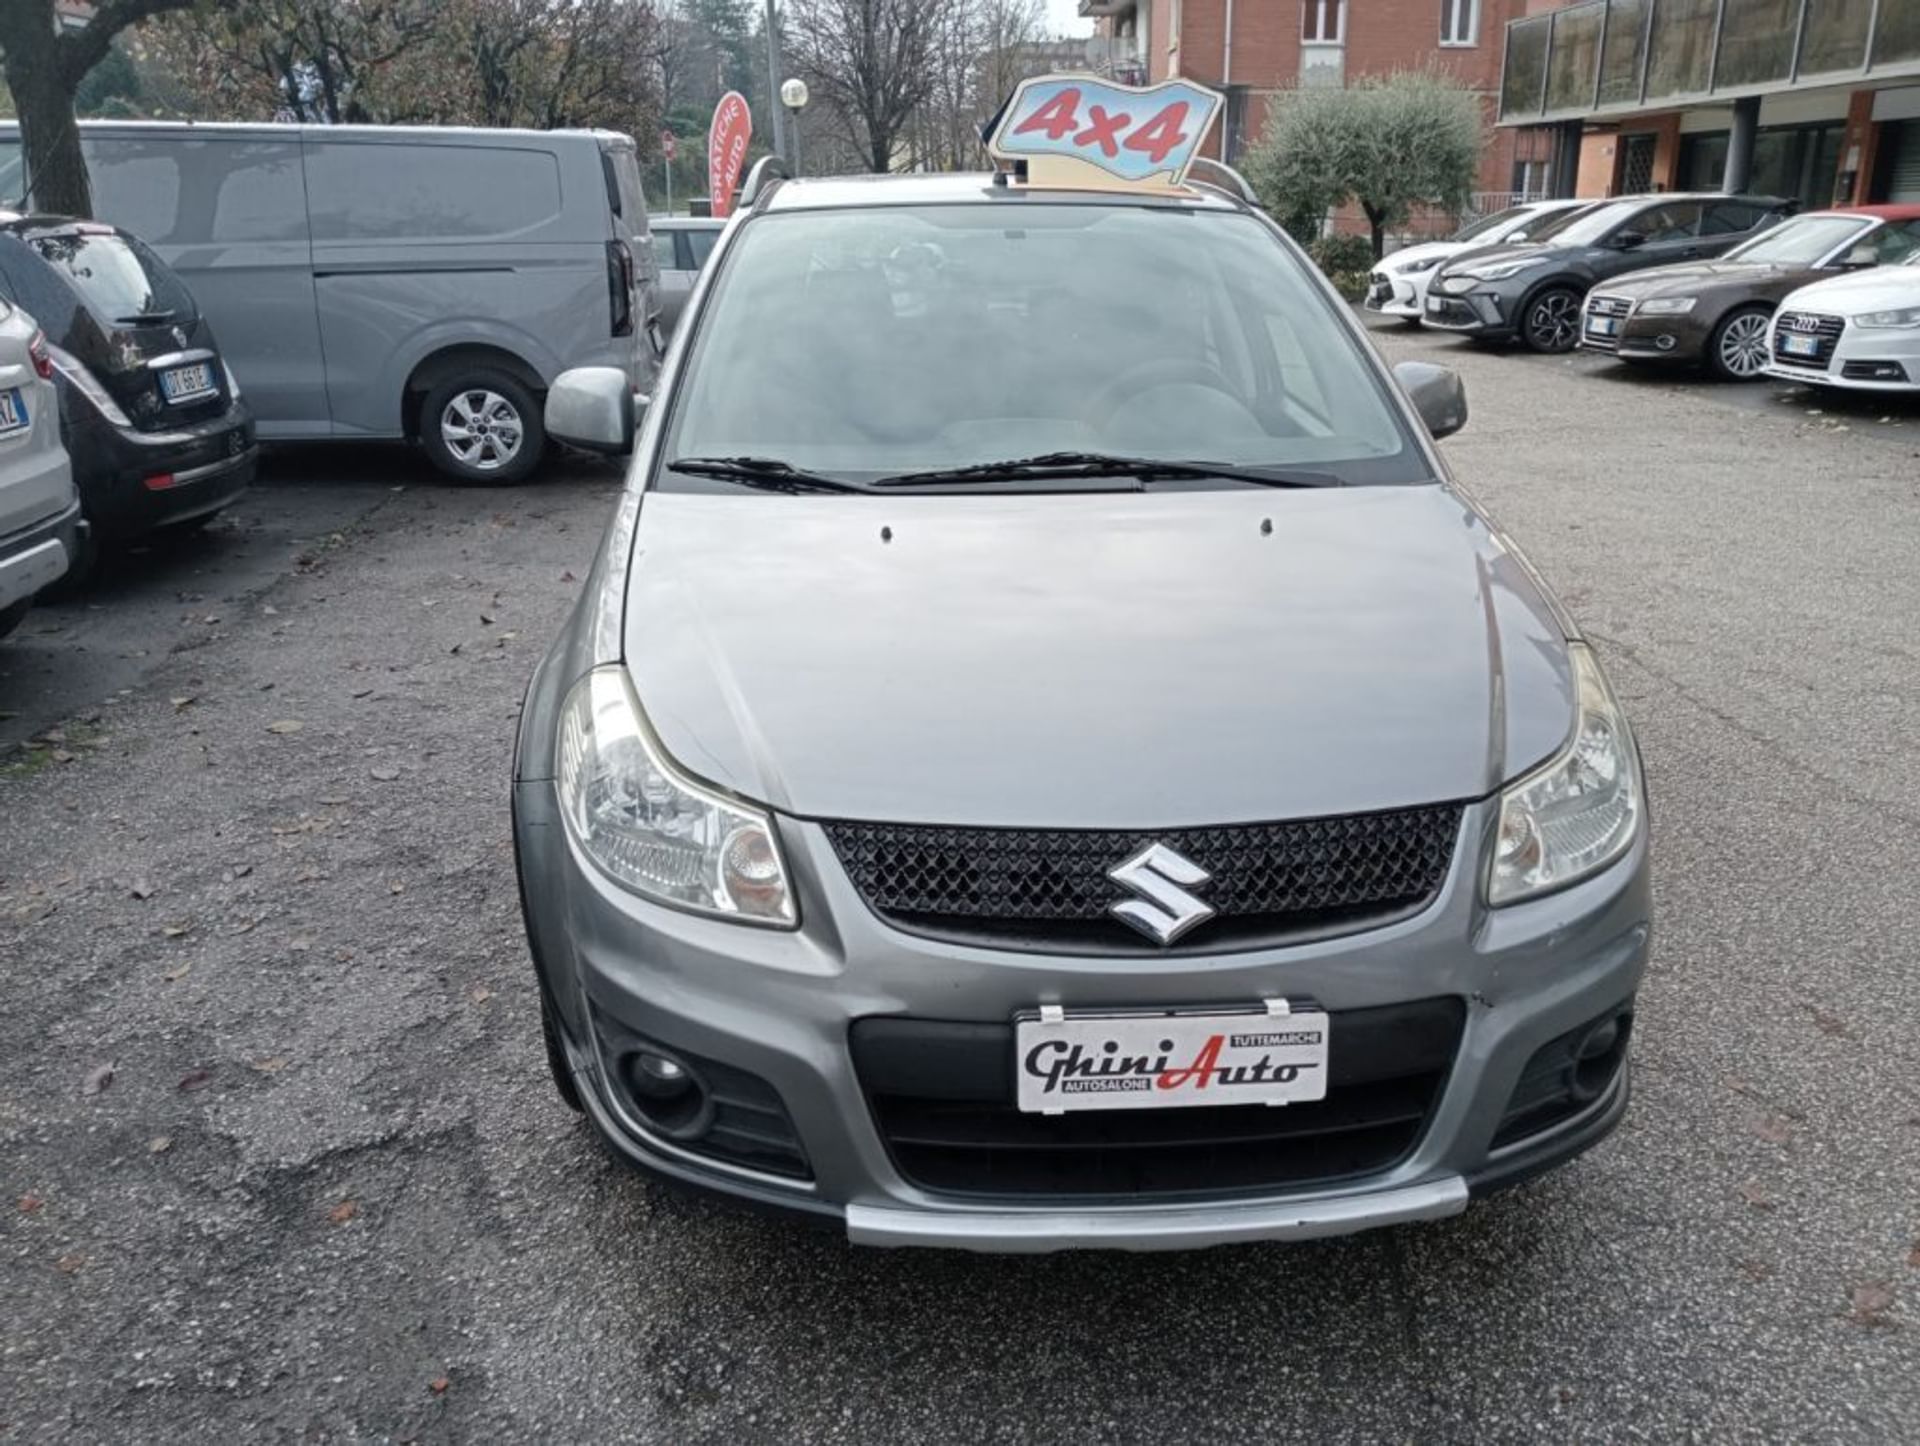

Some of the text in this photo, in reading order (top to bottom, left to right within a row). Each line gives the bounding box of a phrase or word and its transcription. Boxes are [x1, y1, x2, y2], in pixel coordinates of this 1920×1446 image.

[714, 99, 739, 204] PRATICHE
[724, 135, 744, 188] AUTO
[1025, 1035, 1319, 1093] Ghini Auto
[1232, 1032, 1320, 1047] TUTTEMARCHE
[1064, 1079, 1149, 1092] AUTOSALONE
